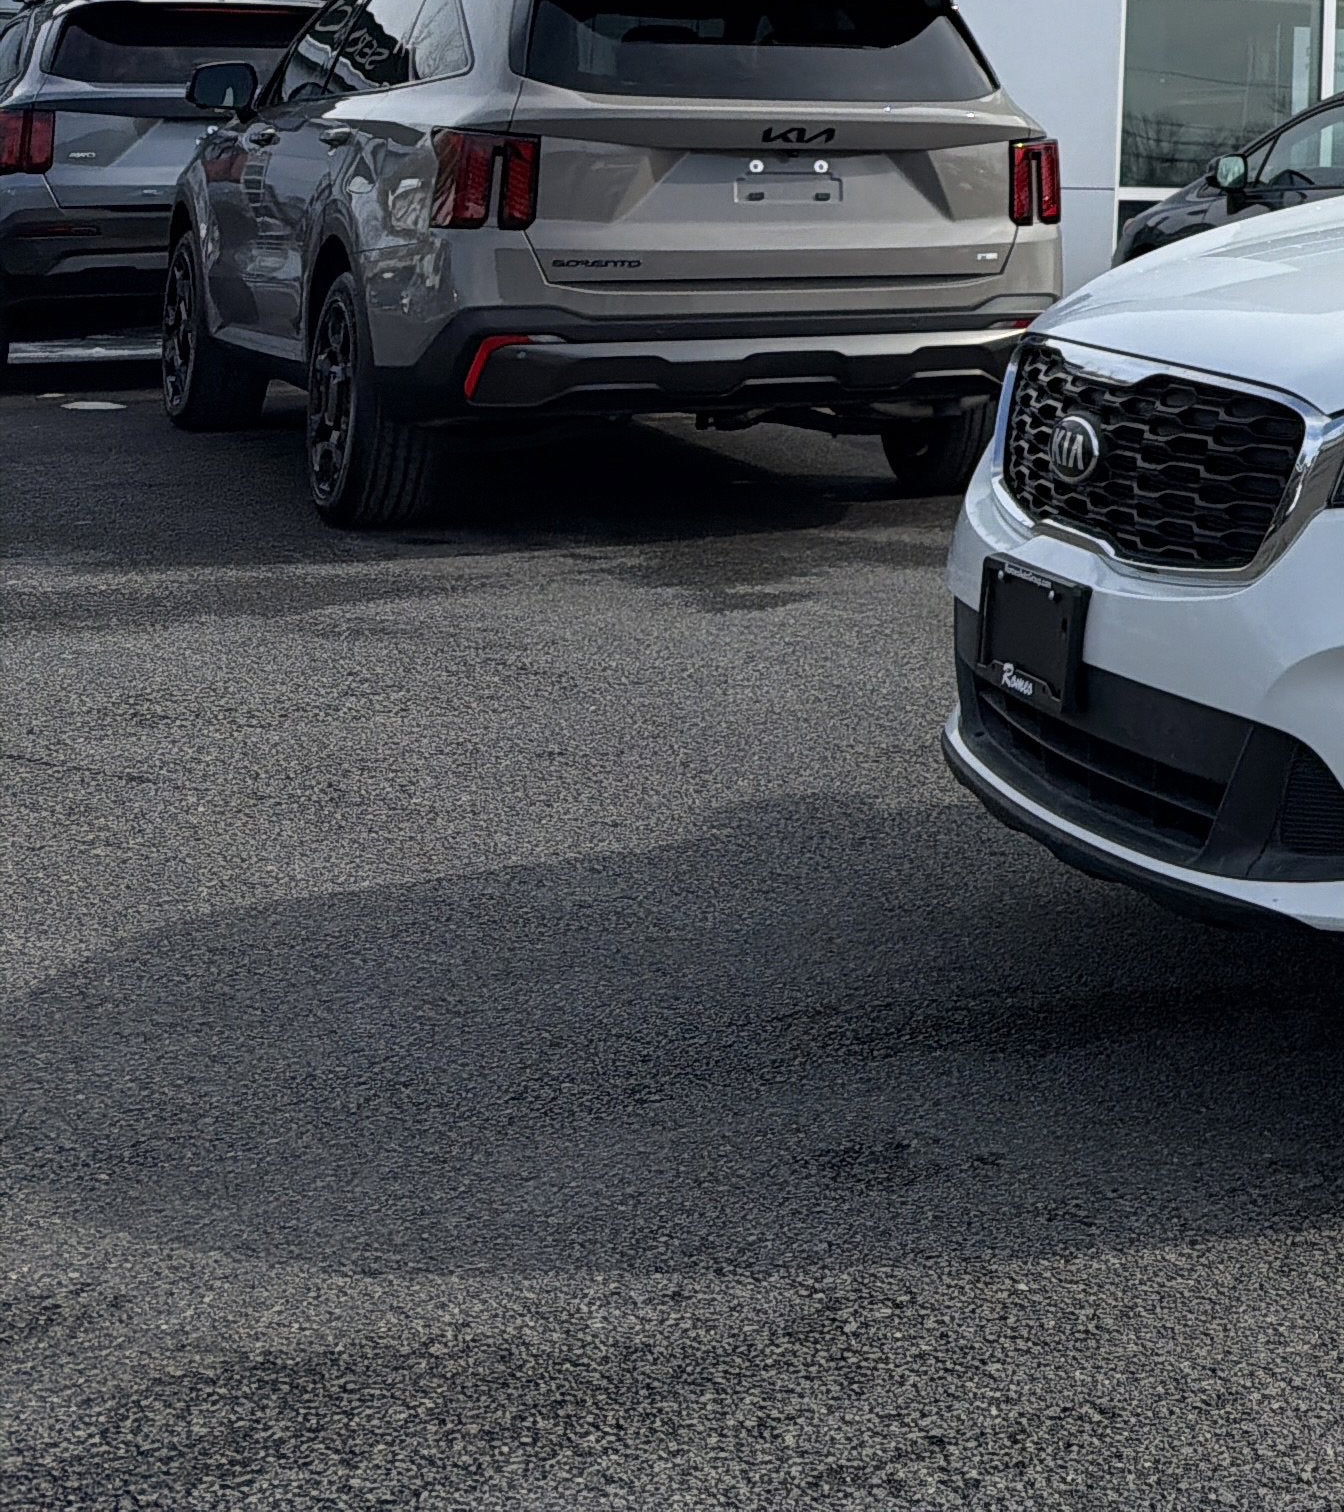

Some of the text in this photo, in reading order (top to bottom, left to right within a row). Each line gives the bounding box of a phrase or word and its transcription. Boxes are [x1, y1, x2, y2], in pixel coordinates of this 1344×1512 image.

[762, 127, 836, 144] KIA
[551, 258, 642, 269] SORENTO
[1052, 428, 1085, 470] KIA
[1001, 662, 1033, 695] Romeo
